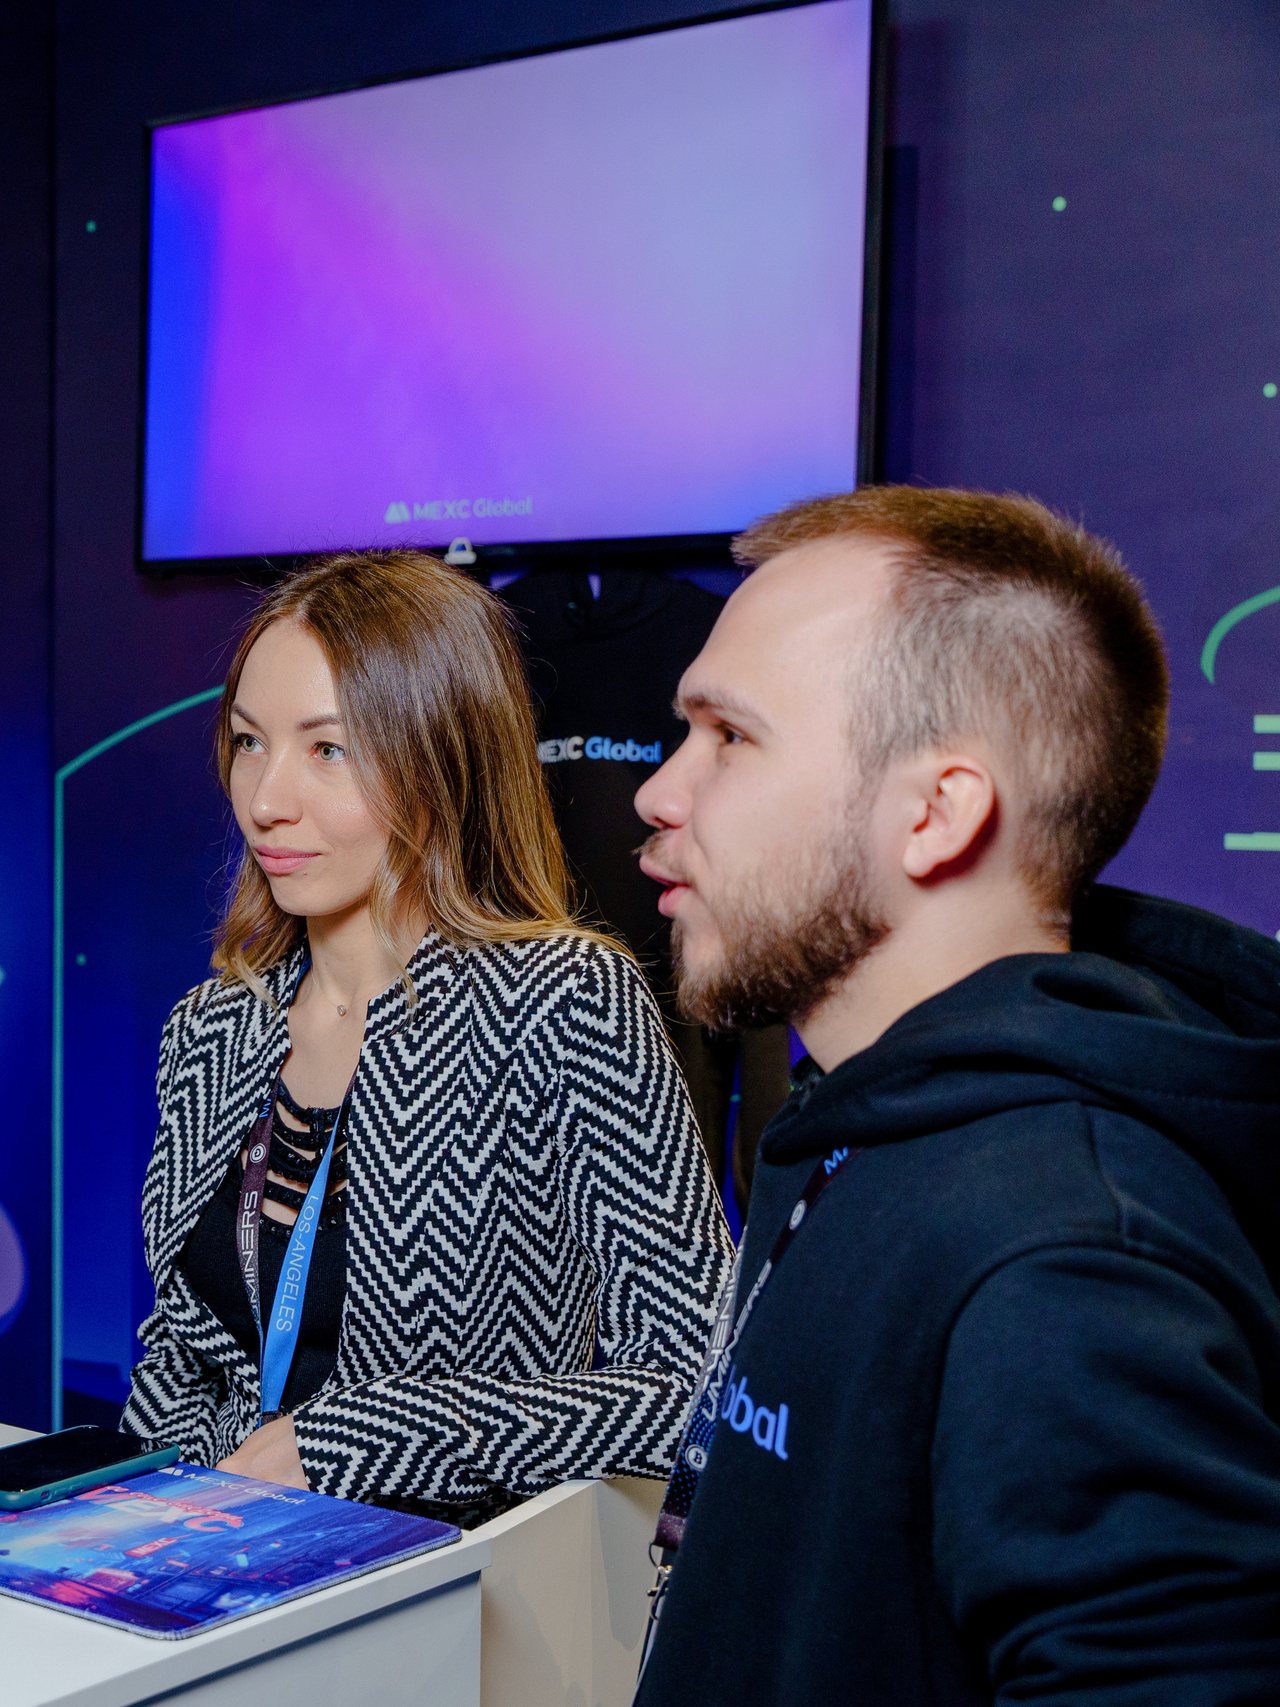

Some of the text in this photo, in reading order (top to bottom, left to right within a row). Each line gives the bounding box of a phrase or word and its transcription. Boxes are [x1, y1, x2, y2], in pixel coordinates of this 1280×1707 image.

[413, 496, 533, 522] MEXC Global
[537, 736, 662, 764] EXC Global
[276, 1195, 319, 1333] LOS-ANGELES
[722, 1364, 789, 1461] obal
[183, 1473, 245, 1490] MEXC
[244, 1487, 307, 1505] Global
